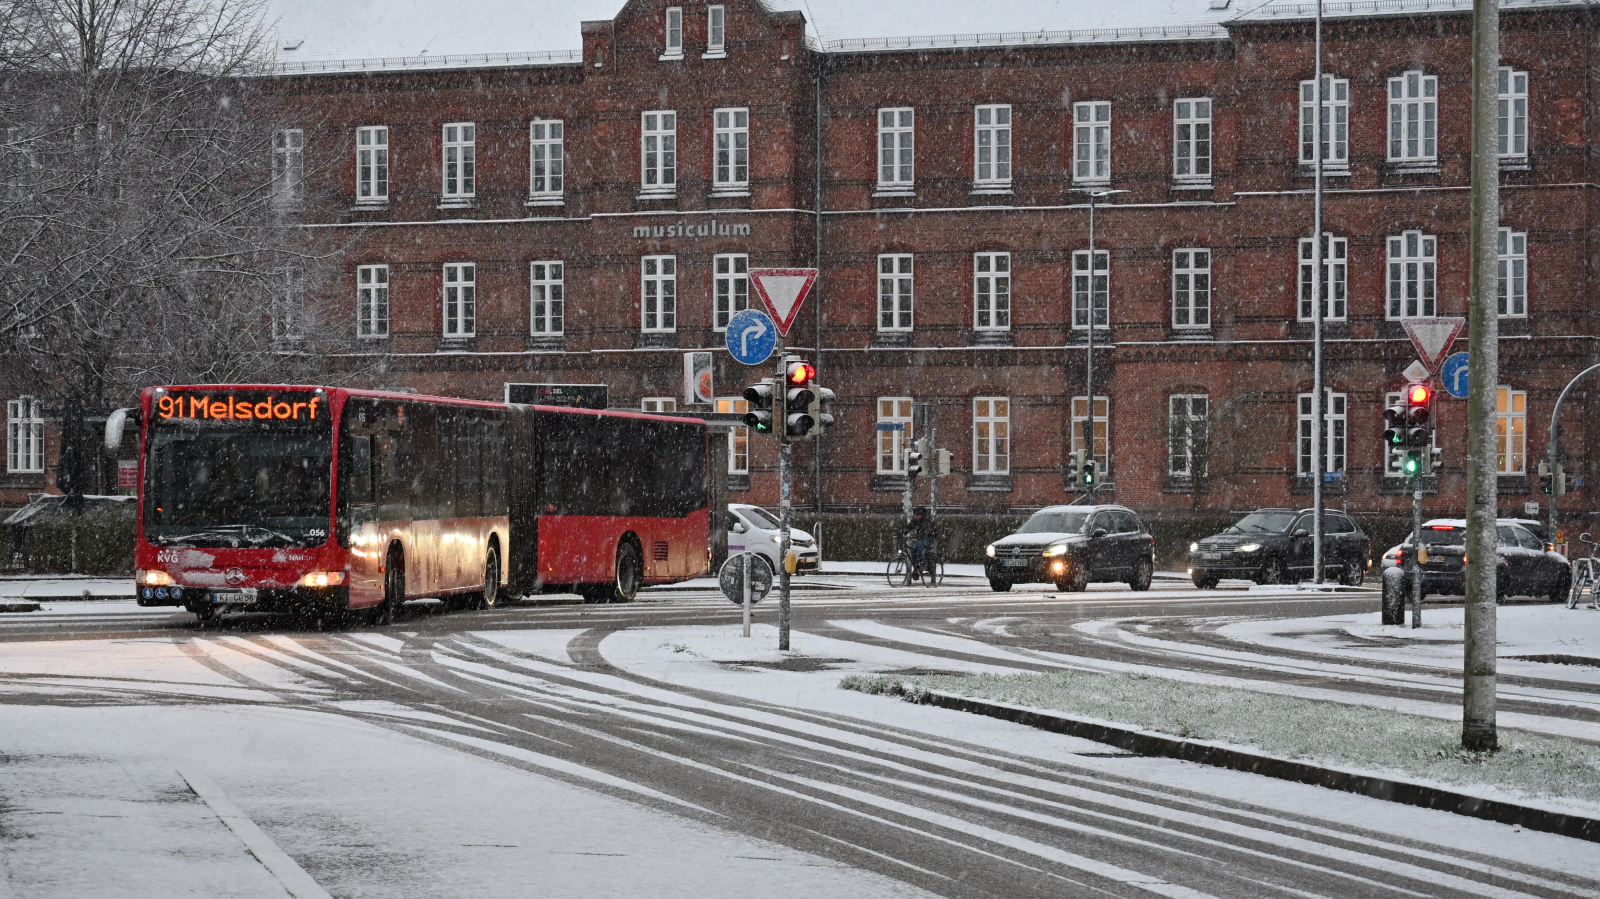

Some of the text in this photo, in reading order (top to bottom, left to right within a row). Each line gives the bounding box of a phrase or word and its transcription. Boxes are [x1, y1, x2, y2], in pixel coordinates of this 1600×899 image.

[633, 219, 751, 238] musiculum
[159, 395, 321, 420] 91 Melsdorf
[309, 529, 325, 537] 056
[157, 553, 179, 563] KVG
[219, 593, 229, 602] KI
